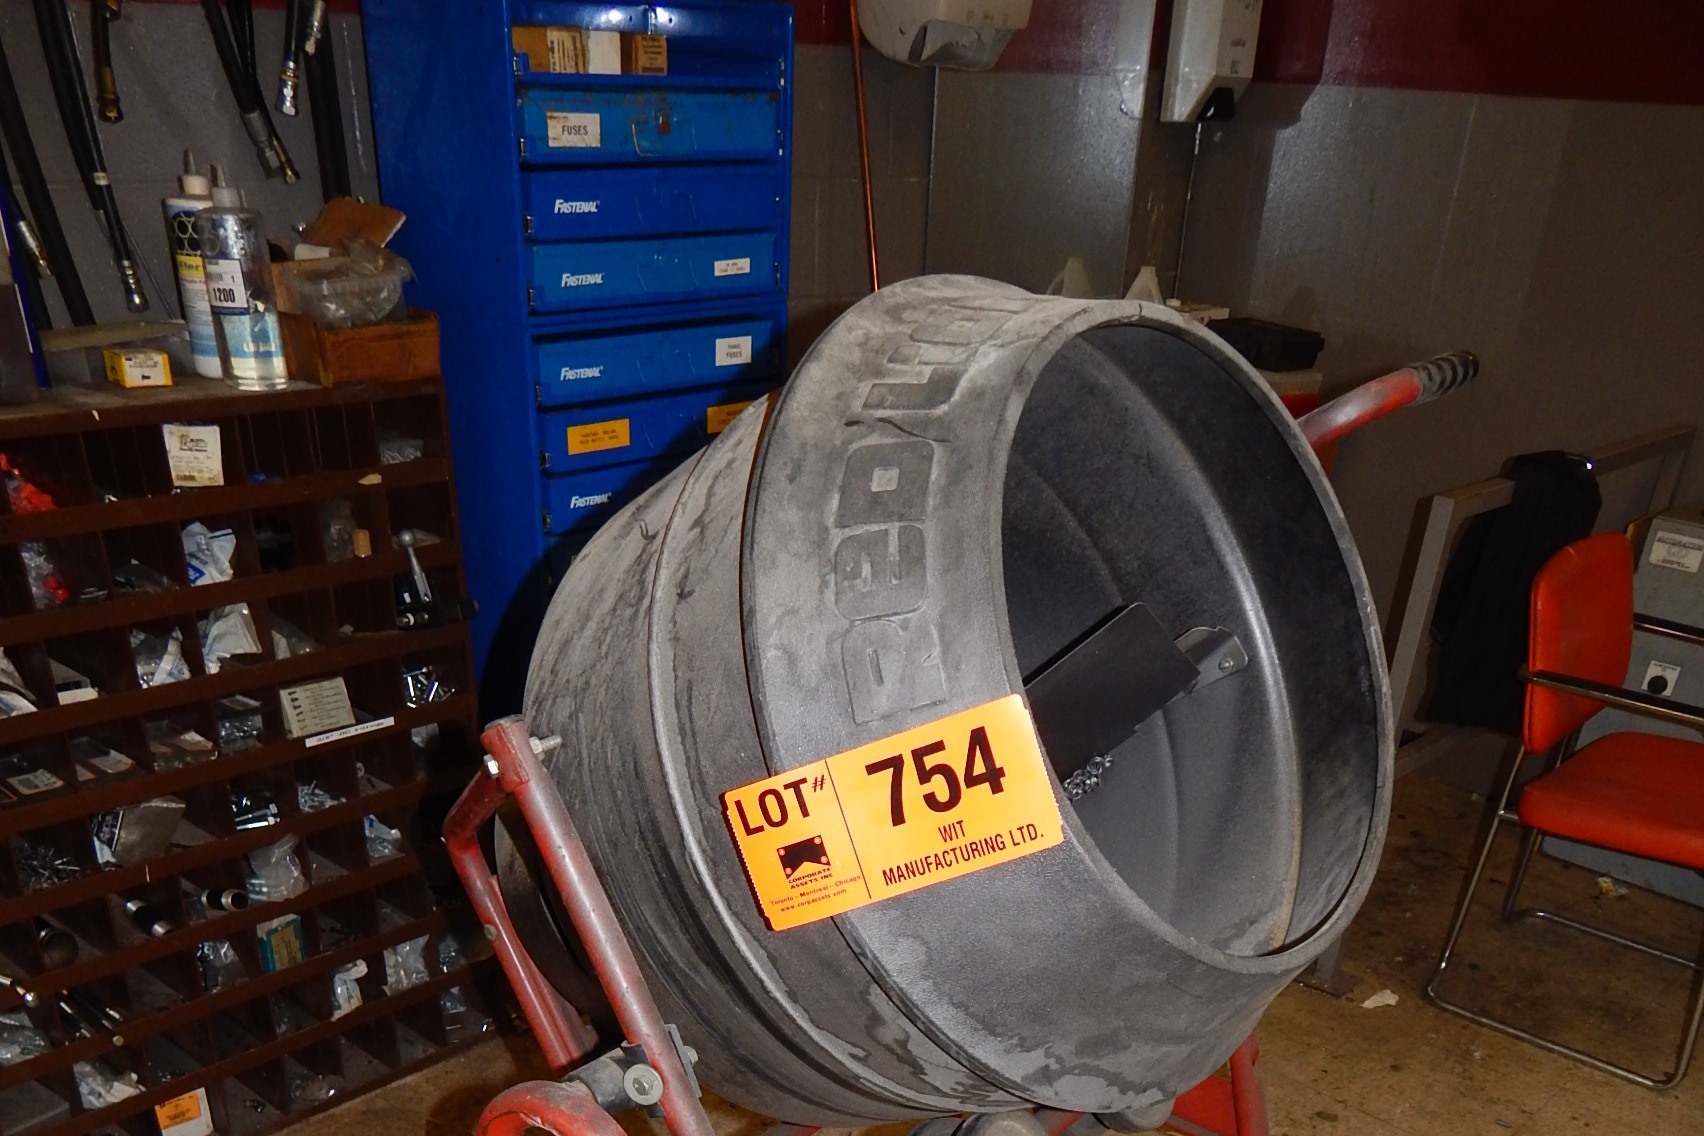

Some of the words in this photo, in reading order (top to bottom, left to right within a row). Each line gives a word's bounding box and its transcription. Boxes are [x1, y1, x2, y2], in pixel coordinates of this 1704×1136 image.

[562, 125, 588, 136] FUSES
[213, 287, 236, 303] 1200
[865, 726, 1006, 827] 754
[938, 820, 966, 843] WIT
[883, 834, 1006, 887] MANUFACTURING
[1009, 823, 1044, 847] LTD.
[788, 867, 832, 884] CORPORATE
[790, 878, 819, 890] ASSETS
[820, 873, 833, 881] INC
[771, 896, 794, 906] Toronto
[799, 885, 828, 898] Montreal
[835, 875, 861, 887] Chicago
